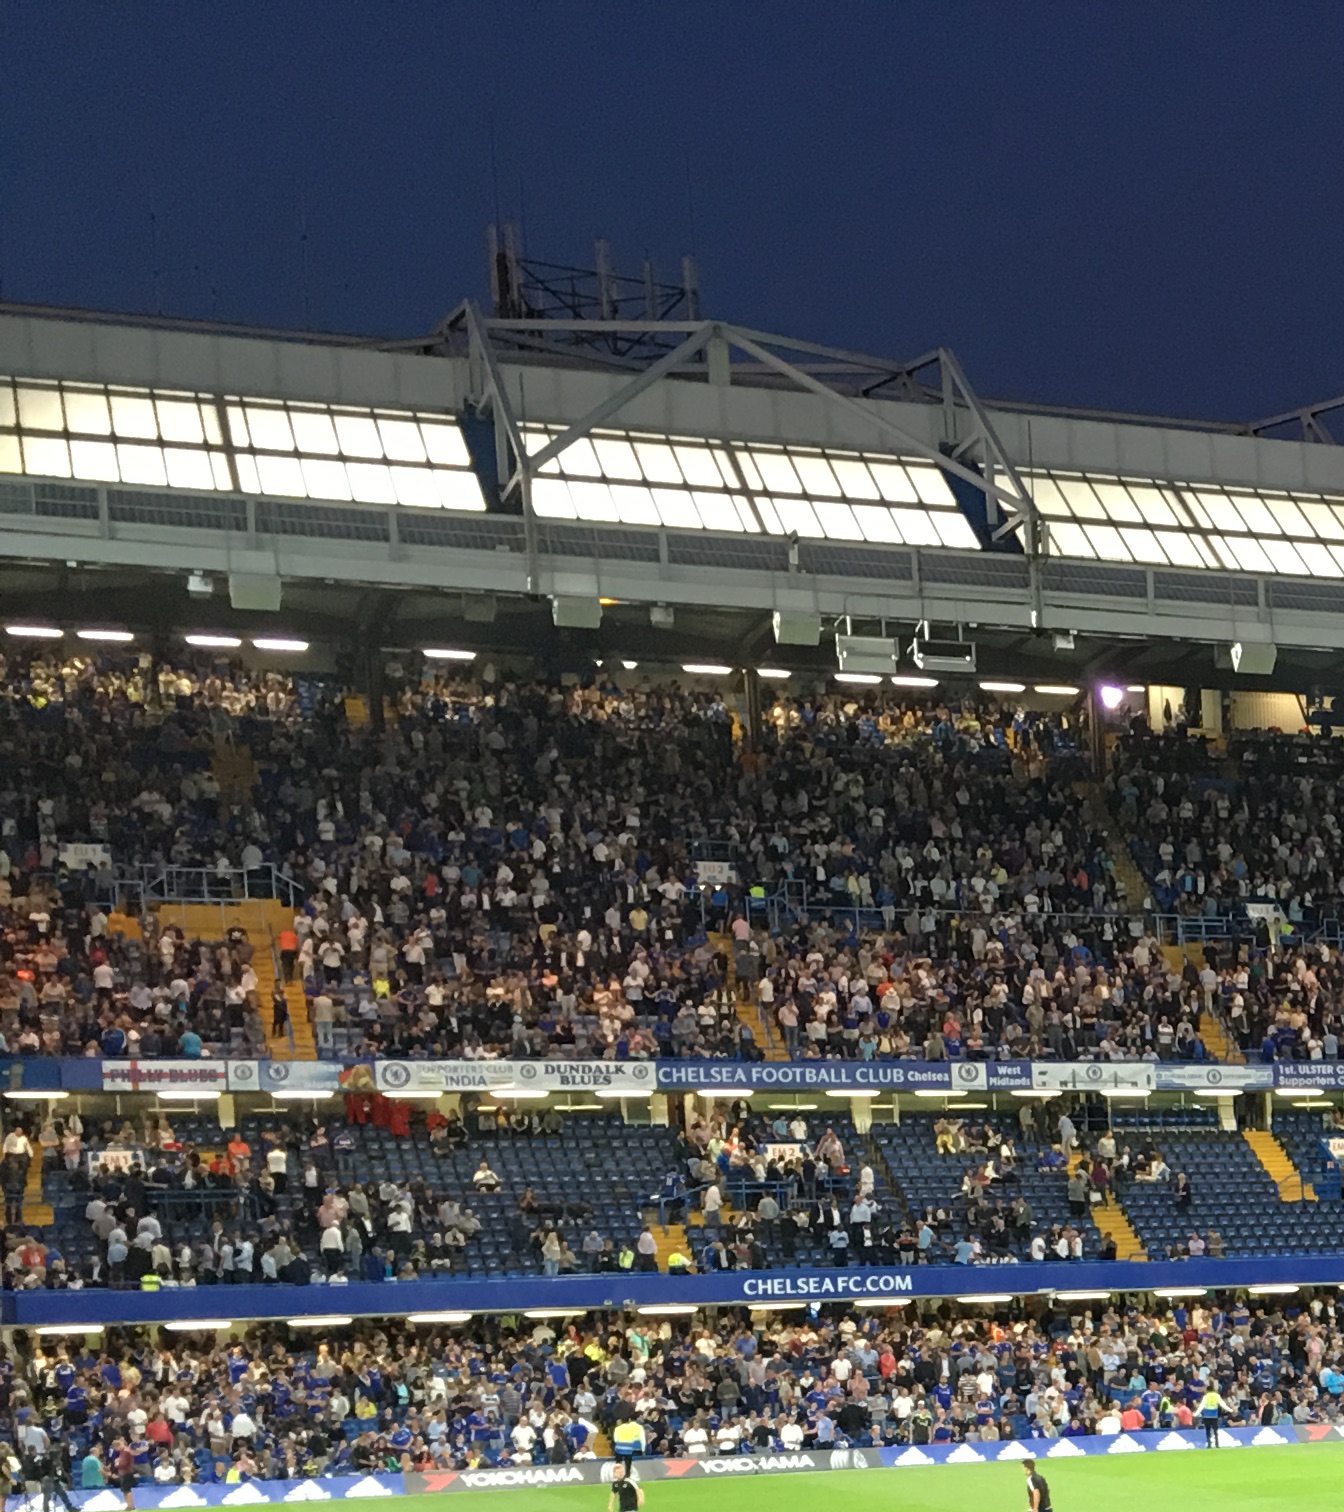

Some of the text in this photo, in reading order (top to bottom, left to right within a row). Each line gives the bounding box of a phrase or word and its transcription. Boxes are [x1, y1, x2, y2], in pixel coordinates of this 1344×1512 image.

[544, 1064, 626, 1075] DUNDALK
[658, 1067, 905, 1083] CHELSEA FOOTBALL CLUB
[997, 1066, 1021, 1075] West
[1279, 1065, 1297, 1075] 1st.
[1299, 1064, 1335, 1075] ULSTER
[169, 1069, 217, 1082] BLUES
[445, 1074, 487, 1087] INDIA
[560, 1075, 612, 1086] BLUES
[908, 1070, 950, 1082] Chelsea
[989, 1076, 1030, 1086] Midlands
[1279, 1076, 1336, 1087] Supporters
[1332, 1141, 1344, 1151] EM
[789, 1147, 796, 1157] 2
[460, 1467, 584, 1488] YOKOHAMA
